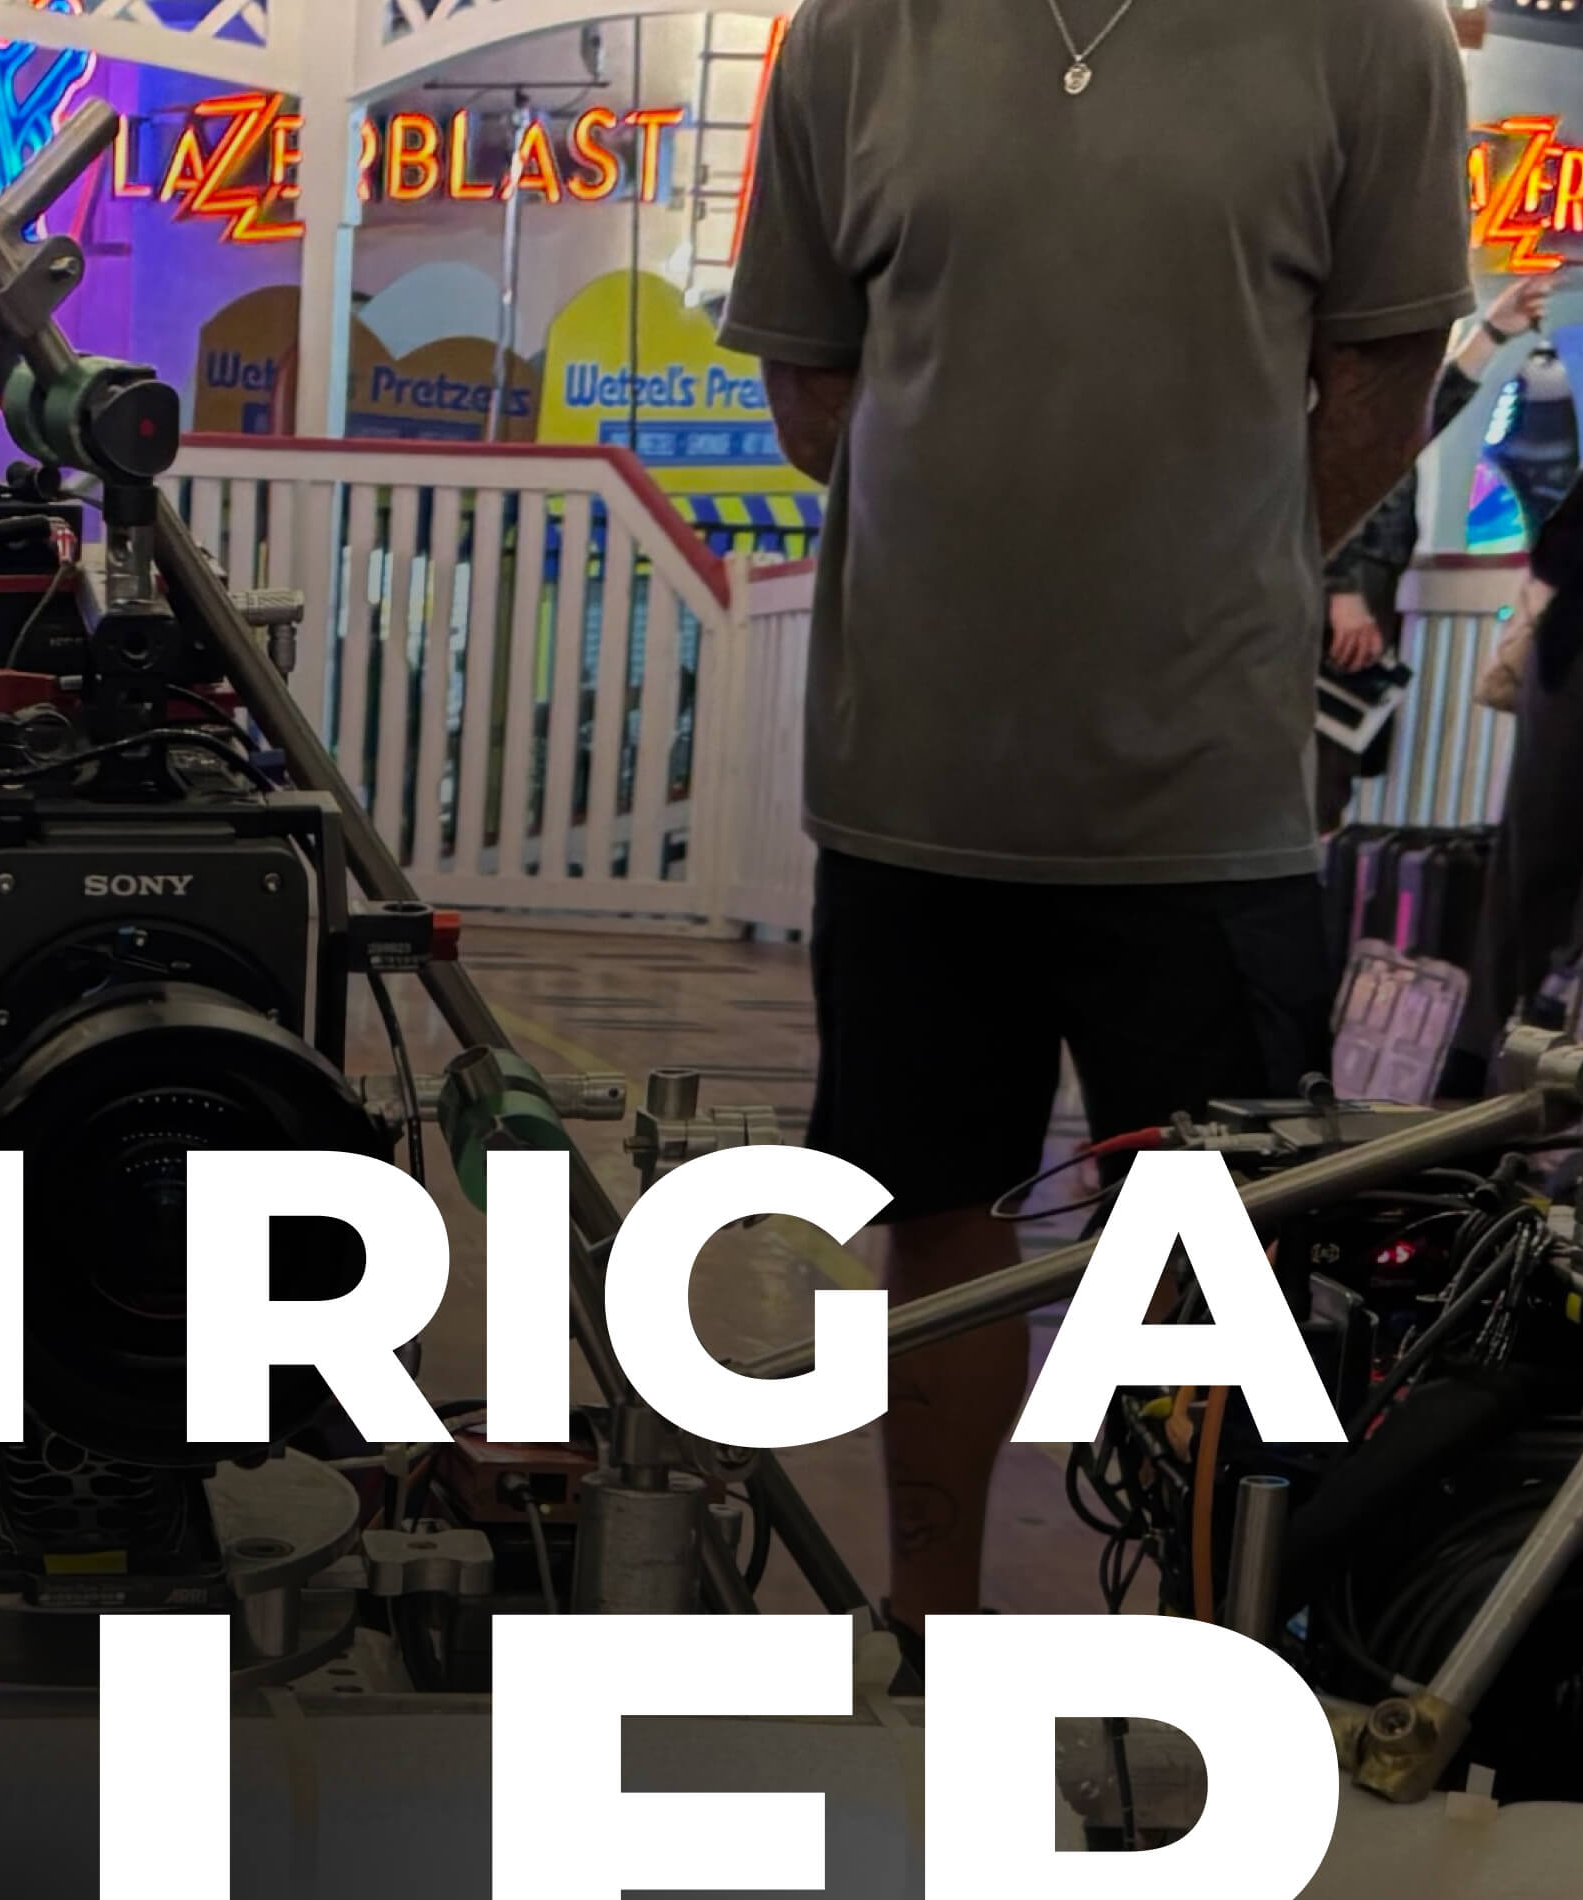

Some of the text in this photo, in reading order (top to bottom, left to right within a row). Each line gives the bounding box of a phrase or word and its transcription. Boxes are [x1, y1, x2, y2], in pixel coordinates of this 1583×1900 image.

[370, 365, 531, 418] Pretzes
[705, 367, 771, 409] Pre
[83, 873, 194, 899] SONY
